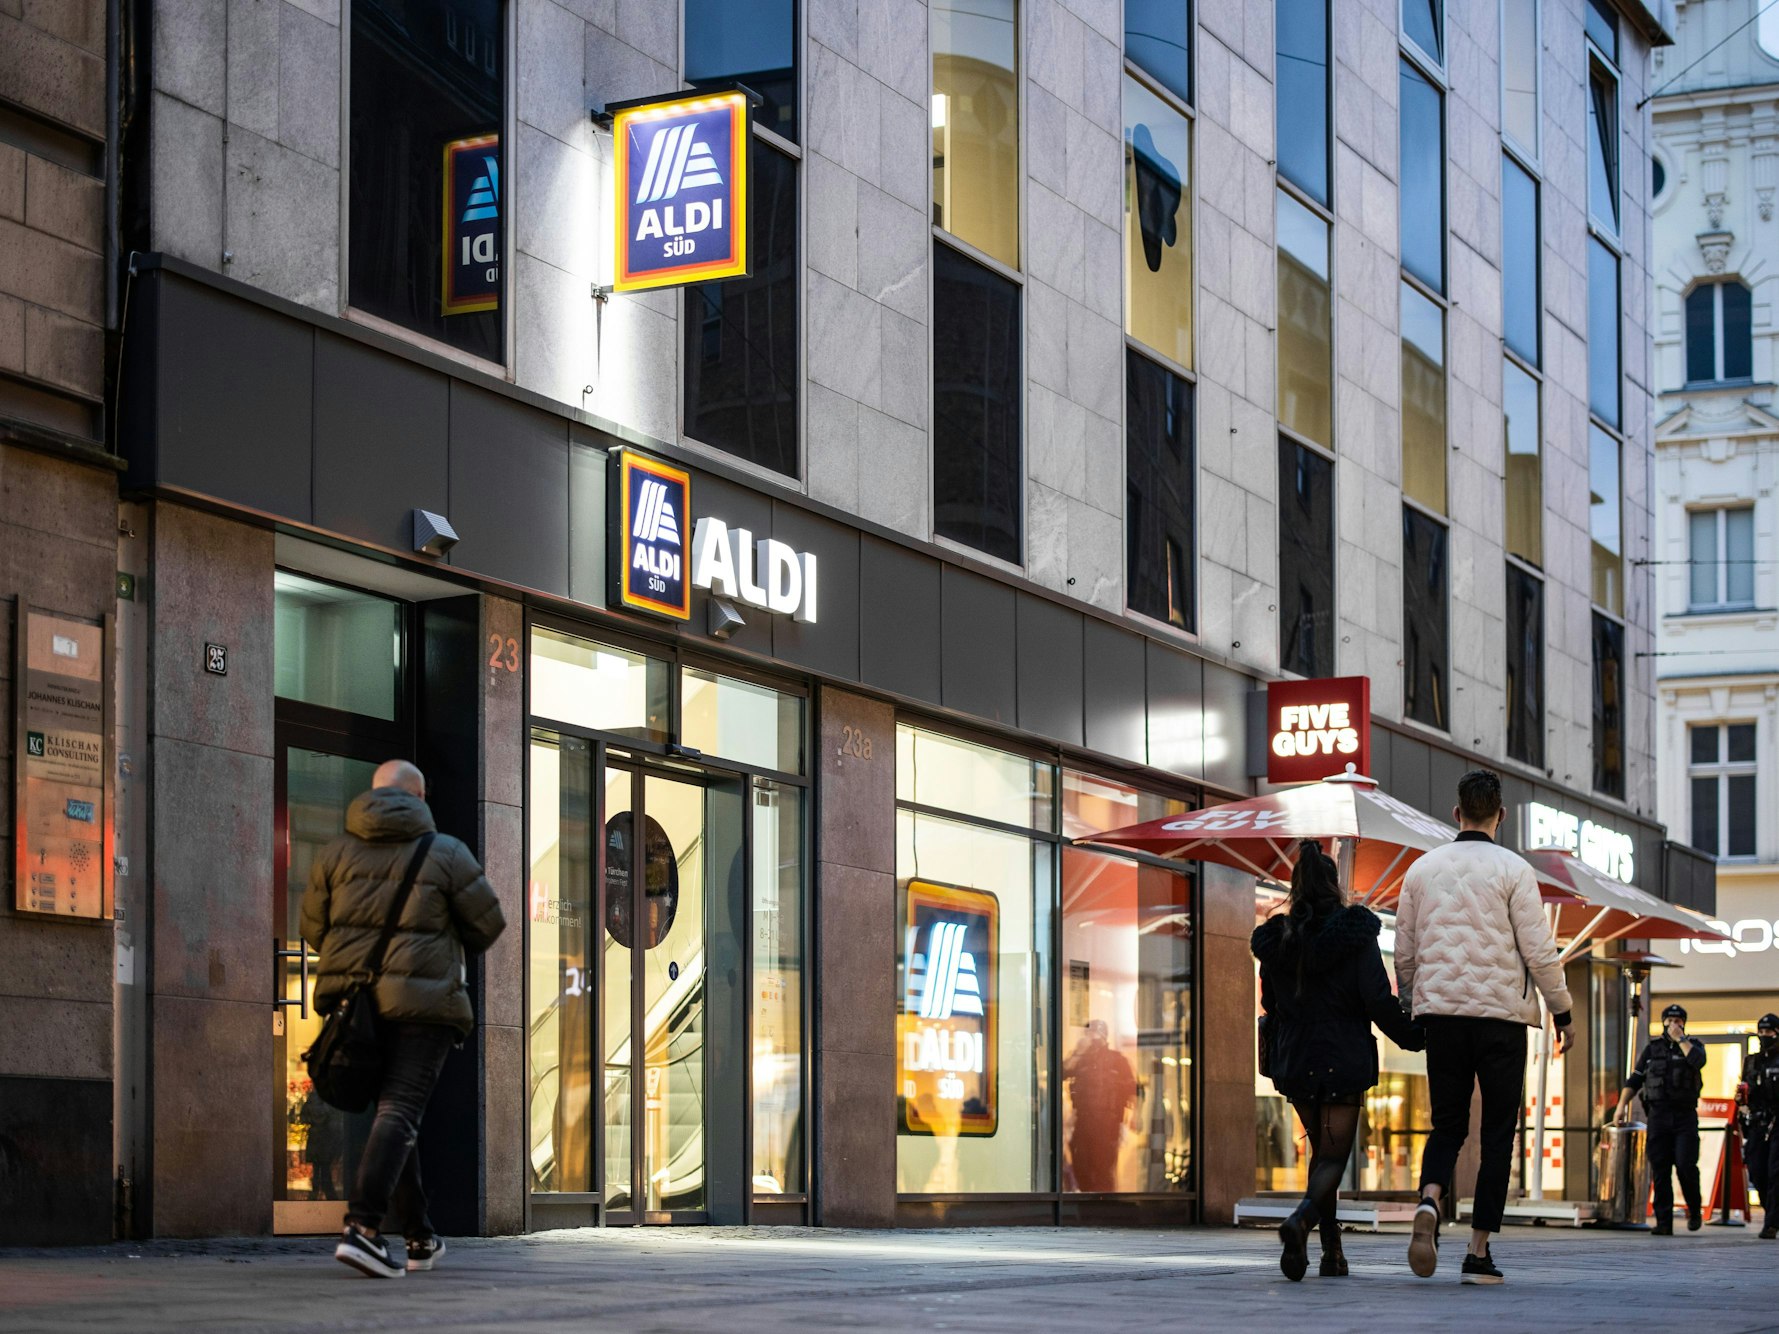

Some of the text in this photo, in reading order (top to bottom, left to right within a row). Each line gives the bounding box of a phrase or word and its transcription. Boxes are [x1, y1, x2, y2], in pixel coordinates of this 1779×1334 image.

[635, 198, 723, 242] ALDI
[663, 236, 696, 258] SÜD
[633, 547, 680, 581] ALDI
[691, 516, 817, 624] ALDI
[648, 576, 666, 593] SÜD
[210, 648, 225, 671] 25
[489, 633, 519, 672] 23
[27, 691, 101, 711] JOHANNES KLISCHAN
[1281, 703, 1350, 731] FIVE
[29, 736, 43, 753] KC
[47, 735, 99, 752] KLISCHAN
[47, 746, 99, 763] CONSULTING
[842, 725, 873, 760] 23a
[1272, 728, 1359, 757] GUYS
